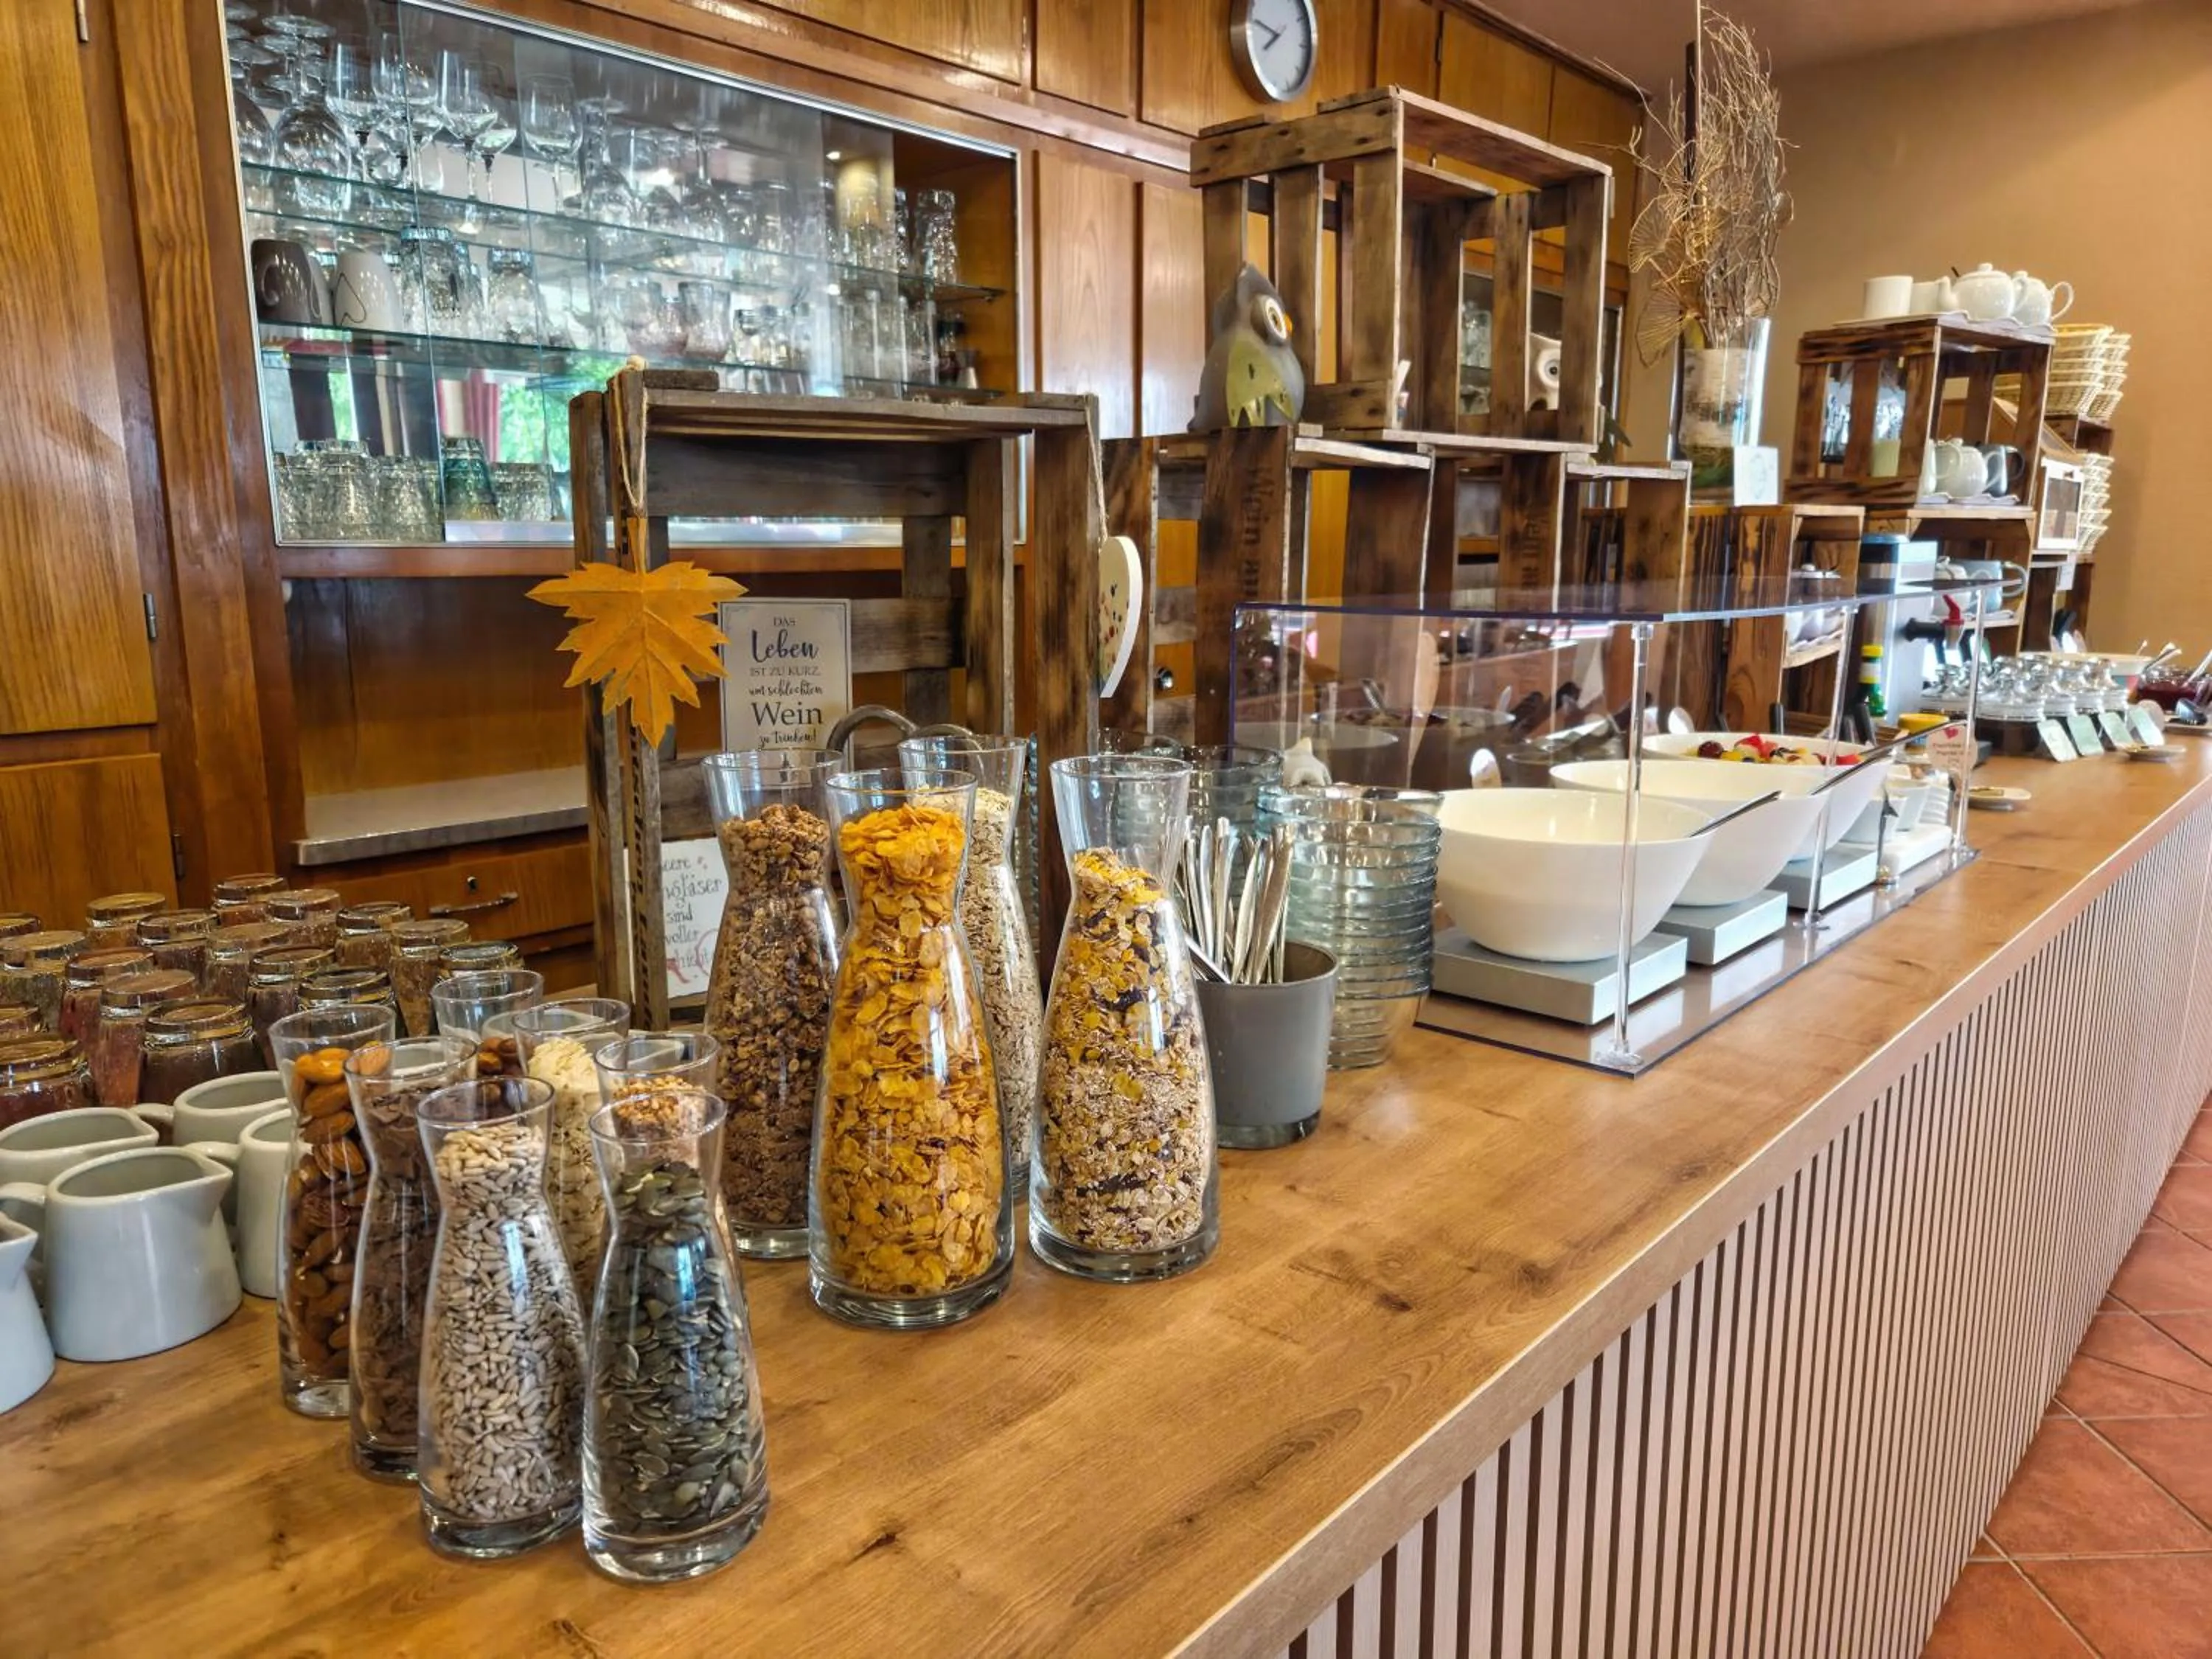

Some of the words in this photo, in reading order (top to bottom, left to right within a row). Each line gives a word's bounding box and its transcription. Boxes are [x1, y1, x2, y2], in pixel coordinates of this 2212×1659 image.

[773, 616, 796, 626] DAS
[751, 628, 819, 663] Leben
[749, 666, 767, 676] IST
[769, 666, 785, 676] ZU
[787, 665, 821, 676] KURZ
[767, 678, 824, 697] schlechten
[751, 700, 823, 726] Wein
[662, 858, 692, 872] eere
[666, 902, 693, 922] sind
[664, 924, 699, 945] voller
